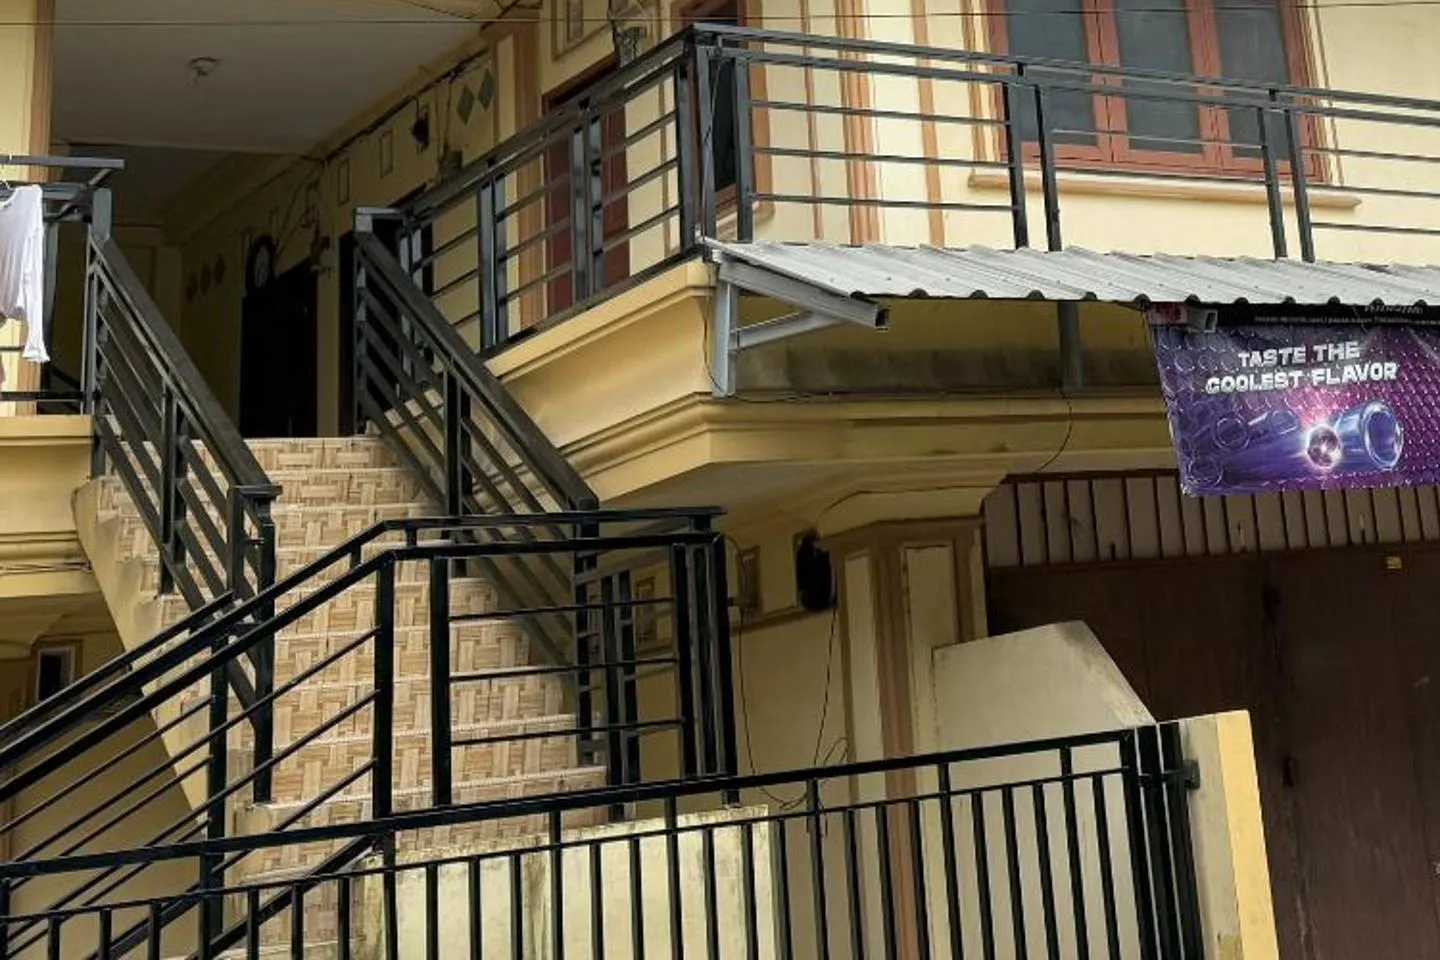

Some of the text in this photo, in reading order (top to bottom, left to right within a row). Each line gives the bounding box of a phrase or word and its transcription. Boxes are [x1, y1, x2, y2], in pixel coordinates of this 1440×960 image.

[1239, 341, 1361, 368] TASTE THE
[1205, 362, 1398, 395] COOLEST FLAVOR
